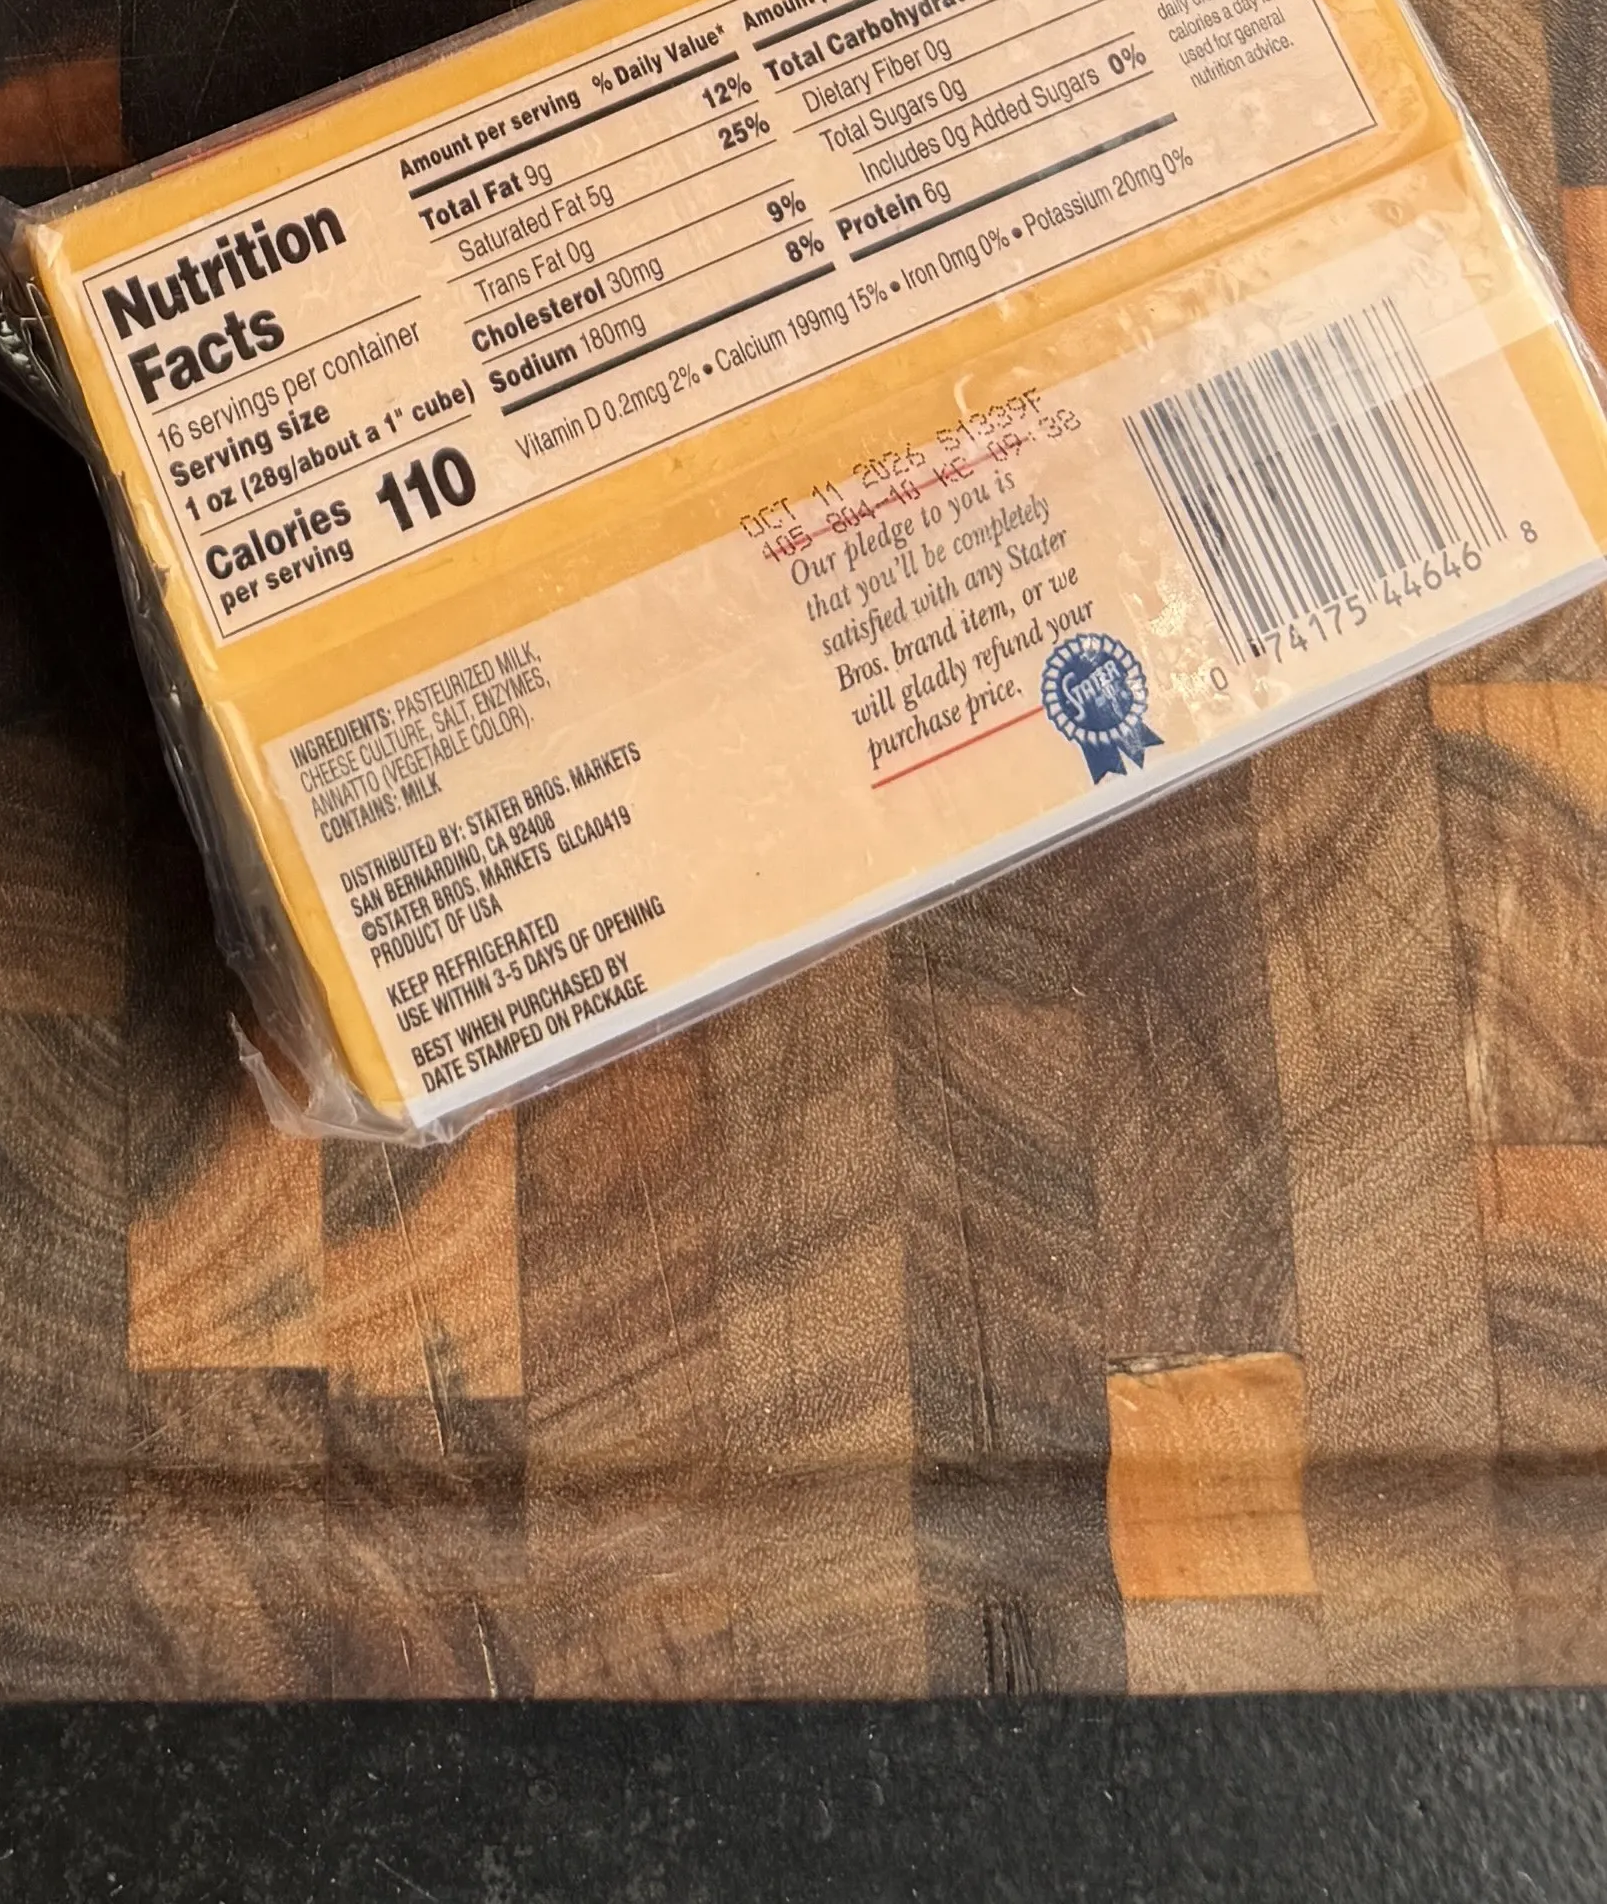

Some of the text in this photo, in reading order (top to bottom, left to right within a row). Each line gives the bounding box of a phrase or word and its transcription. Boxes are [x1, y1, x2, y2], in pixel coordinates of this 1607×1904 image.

[762, 40, 826, 81] Total
[801, 71, 871, 113] Dietary
[871, 49, 923, 84] Fiber
[922, 38, 953, 62] 0g
[1178, 6, 1286, 67] used for general
[1189, 35, 1294, 88] nutrition advice.
[399, 132, 473, 179] Amount
[474, 120, 506, 150] per
[510, 90, 581, 130] serving
[591, 71, 614, 94] %
[612, 54, 663, 85] Daily
[418, 73, 752, 230] Total Fat 9g 12%
[458, 111, 770, 262] Saturated Fat 5g 25%
[835, 180, 951, 241] Protein 6g
[101, 207, 347, 340] Nutrition
[471, 190, 807, 352] Cholesterol 30mg 9%
[473, 239, 595, 302] Trans Fat 0g
[488, 230, 825, 393] Sodium 180mg 8%
[127, 310, 285, 404] Facts
[157, 321, 419, 452] 16 servings per container
[169, 405, 330, 487] Serving size
[185, 495, 201, 521] 1
[206, 485, 237, 512] oz
[240, 429, 362, 503] (28g/about
[364, 425, 381, 443] a
[411, 378, 475, 422] cube)
[375, 447, 476, 532] 110
[739, 442, 926, 538] OCT 11 2026
[205, 499, 352, 580] Calories
[219, 538, 354, 616] per serving
[790, 468, 1015, 585] Our pledge to you is
[822, 529, 1067, 656] satisfied with any Stater
[835, 567, 1078, 692] Bros. brand item, or we
[1209, 520, 1538, 694] 0 74175 44646 8
[289, 641, 542, 768] INGREDIENTS: PASTEURIZED MILK,
[851, 600, 1093, 726] will gladly refund your
[867, 679, 1022, 770] purchase price.
[339, 741, 641, 893] DISTRIBUTED BY: STATER BROS. MARKETS
[350, 810, 556, 918] SAN BERNARDINO, CA 92408
[385, 912, 560, 1007] KEEP REFRIGERATED
[396, 895, 666, 1032] USE WITHIN 3-5 DAYS OF OPENING
[410, 951, 629, 1068] BEST WHEN PURCHASED BY
[421, 973, 648, 1093] DATE STAMPED ON PACKAGE
